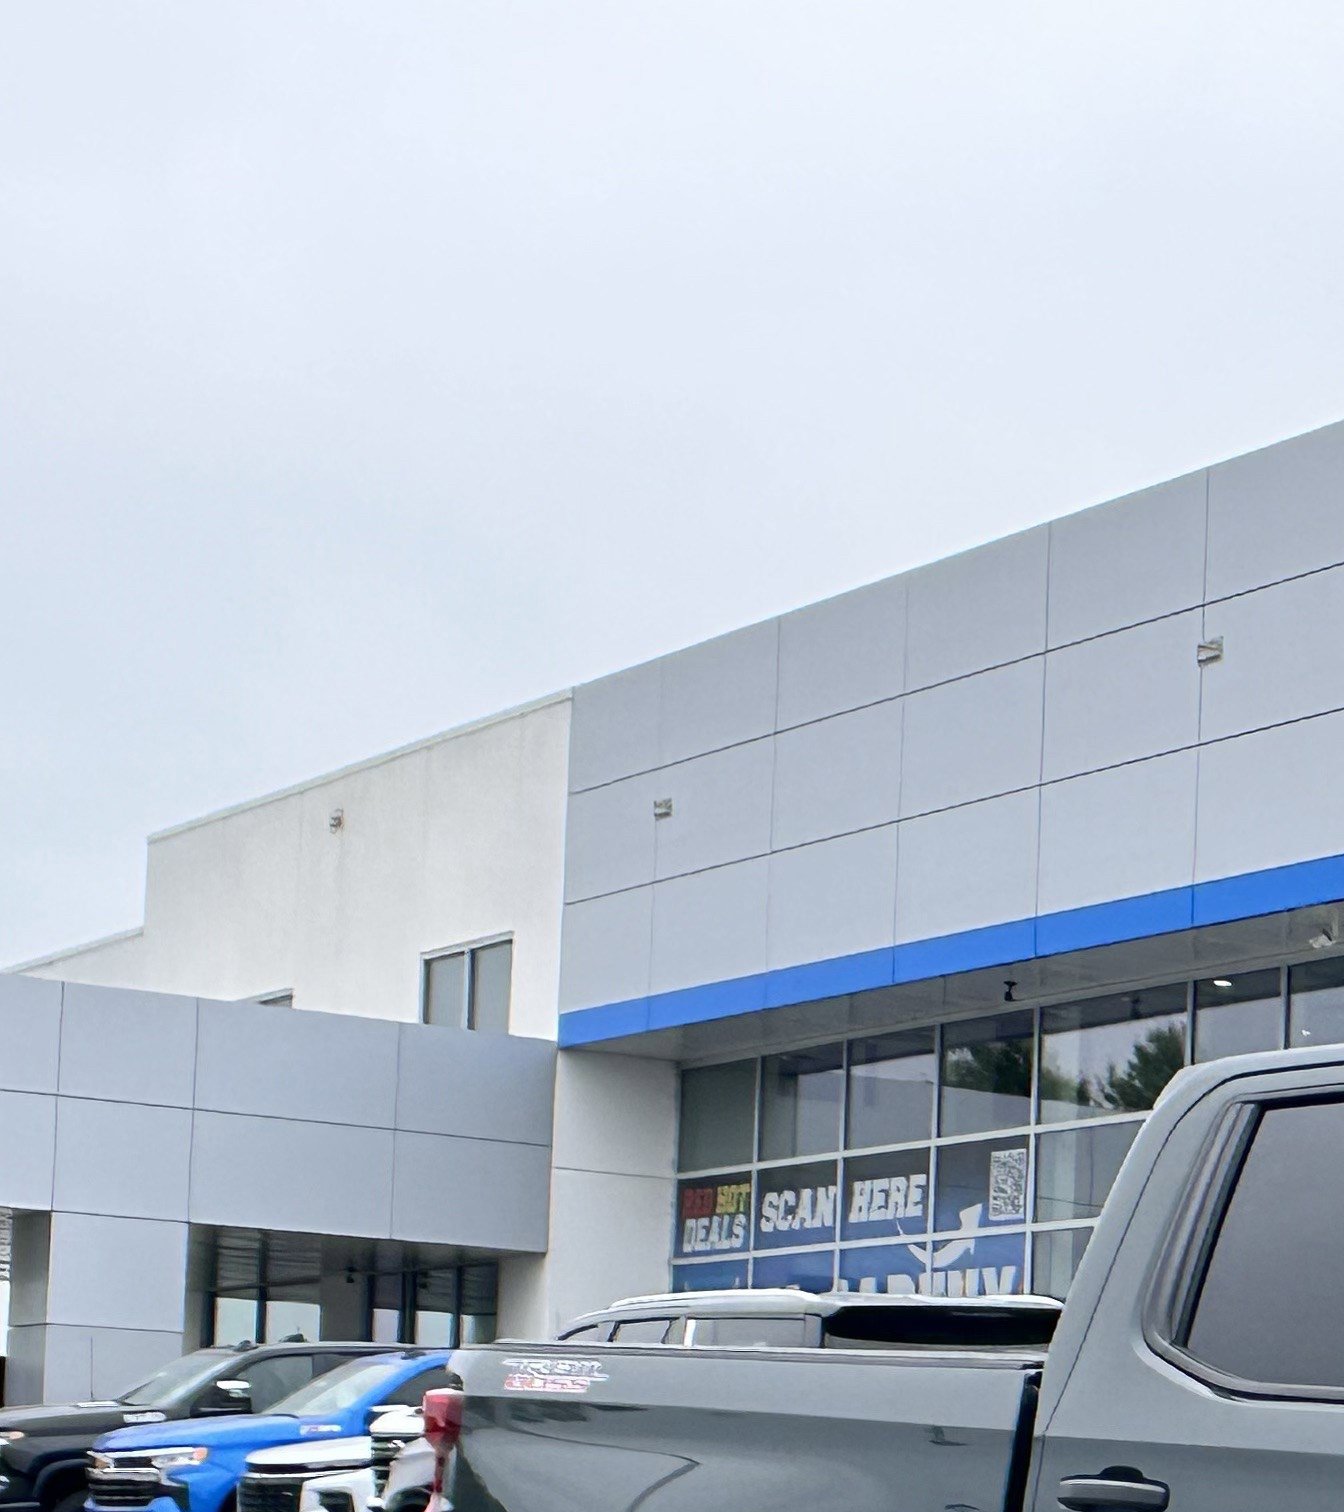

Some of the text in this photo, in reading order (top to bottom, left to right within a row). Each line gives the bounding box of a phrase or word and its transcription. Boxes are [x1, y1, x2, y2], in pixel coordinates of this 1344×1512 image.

[759, 1174, 927, 1233] SCAN HERE
[683, 1214, 747, 1253] DEALS
